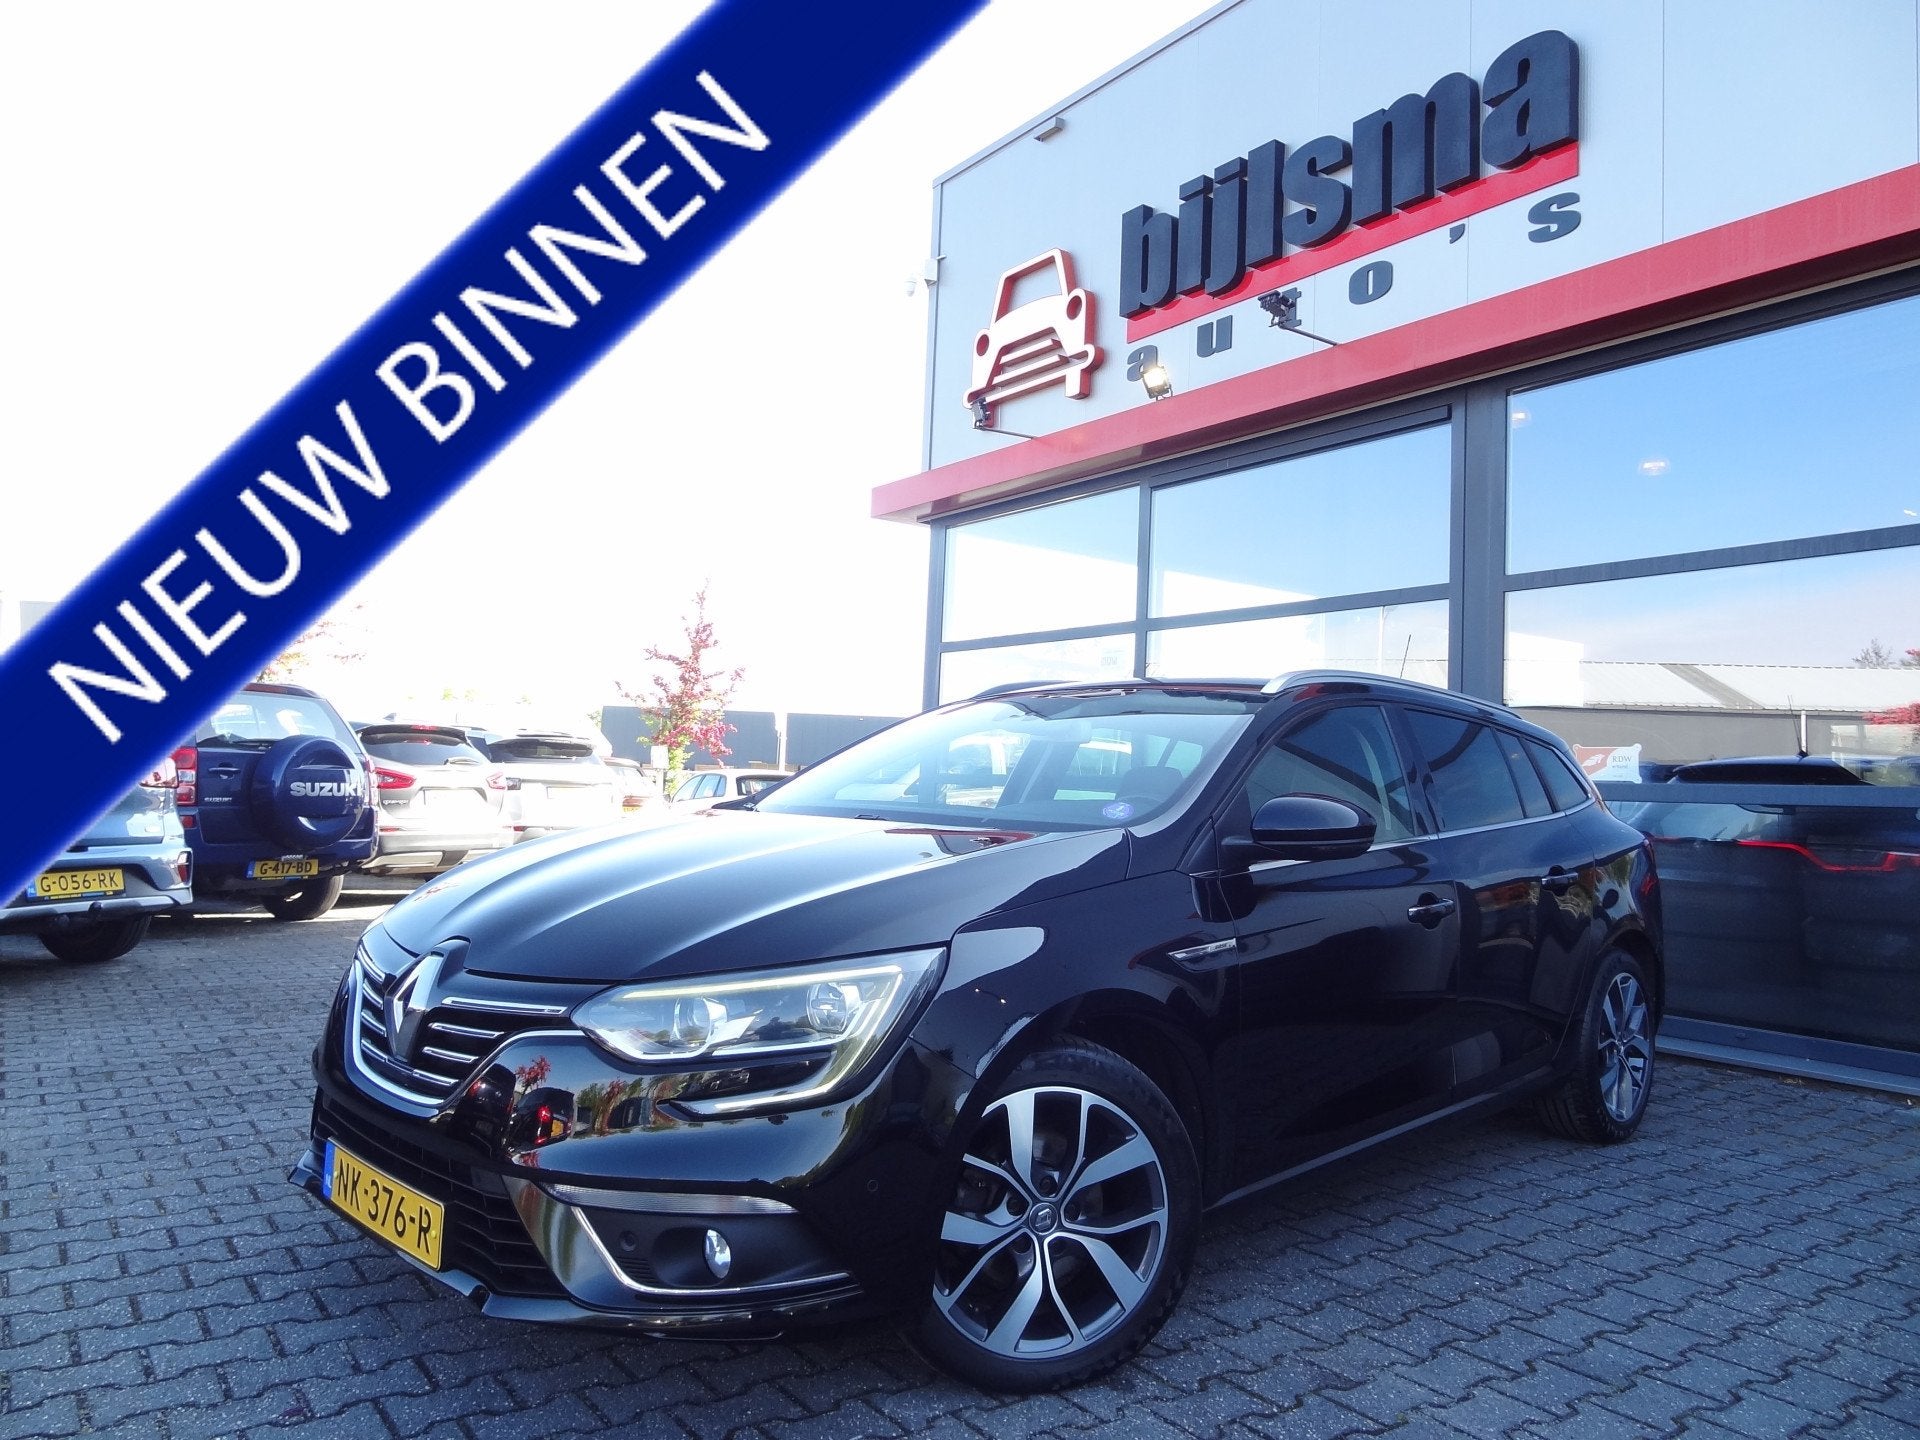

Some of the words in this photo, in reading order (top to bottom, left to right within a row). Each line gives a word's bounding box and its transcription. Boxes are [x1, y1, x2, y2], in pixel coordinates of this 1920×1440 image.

[1119, 29, 1580, 318] bijlsma
[1612, 755, 1632, 763] RDW
[290, 781, 363, 797] SUZUKI
[259, 861, 313, 875] G-417-BD
[40, 871, 119, 893] G-056-RK
[337, 1157, 432, 1255] NK-376-R
